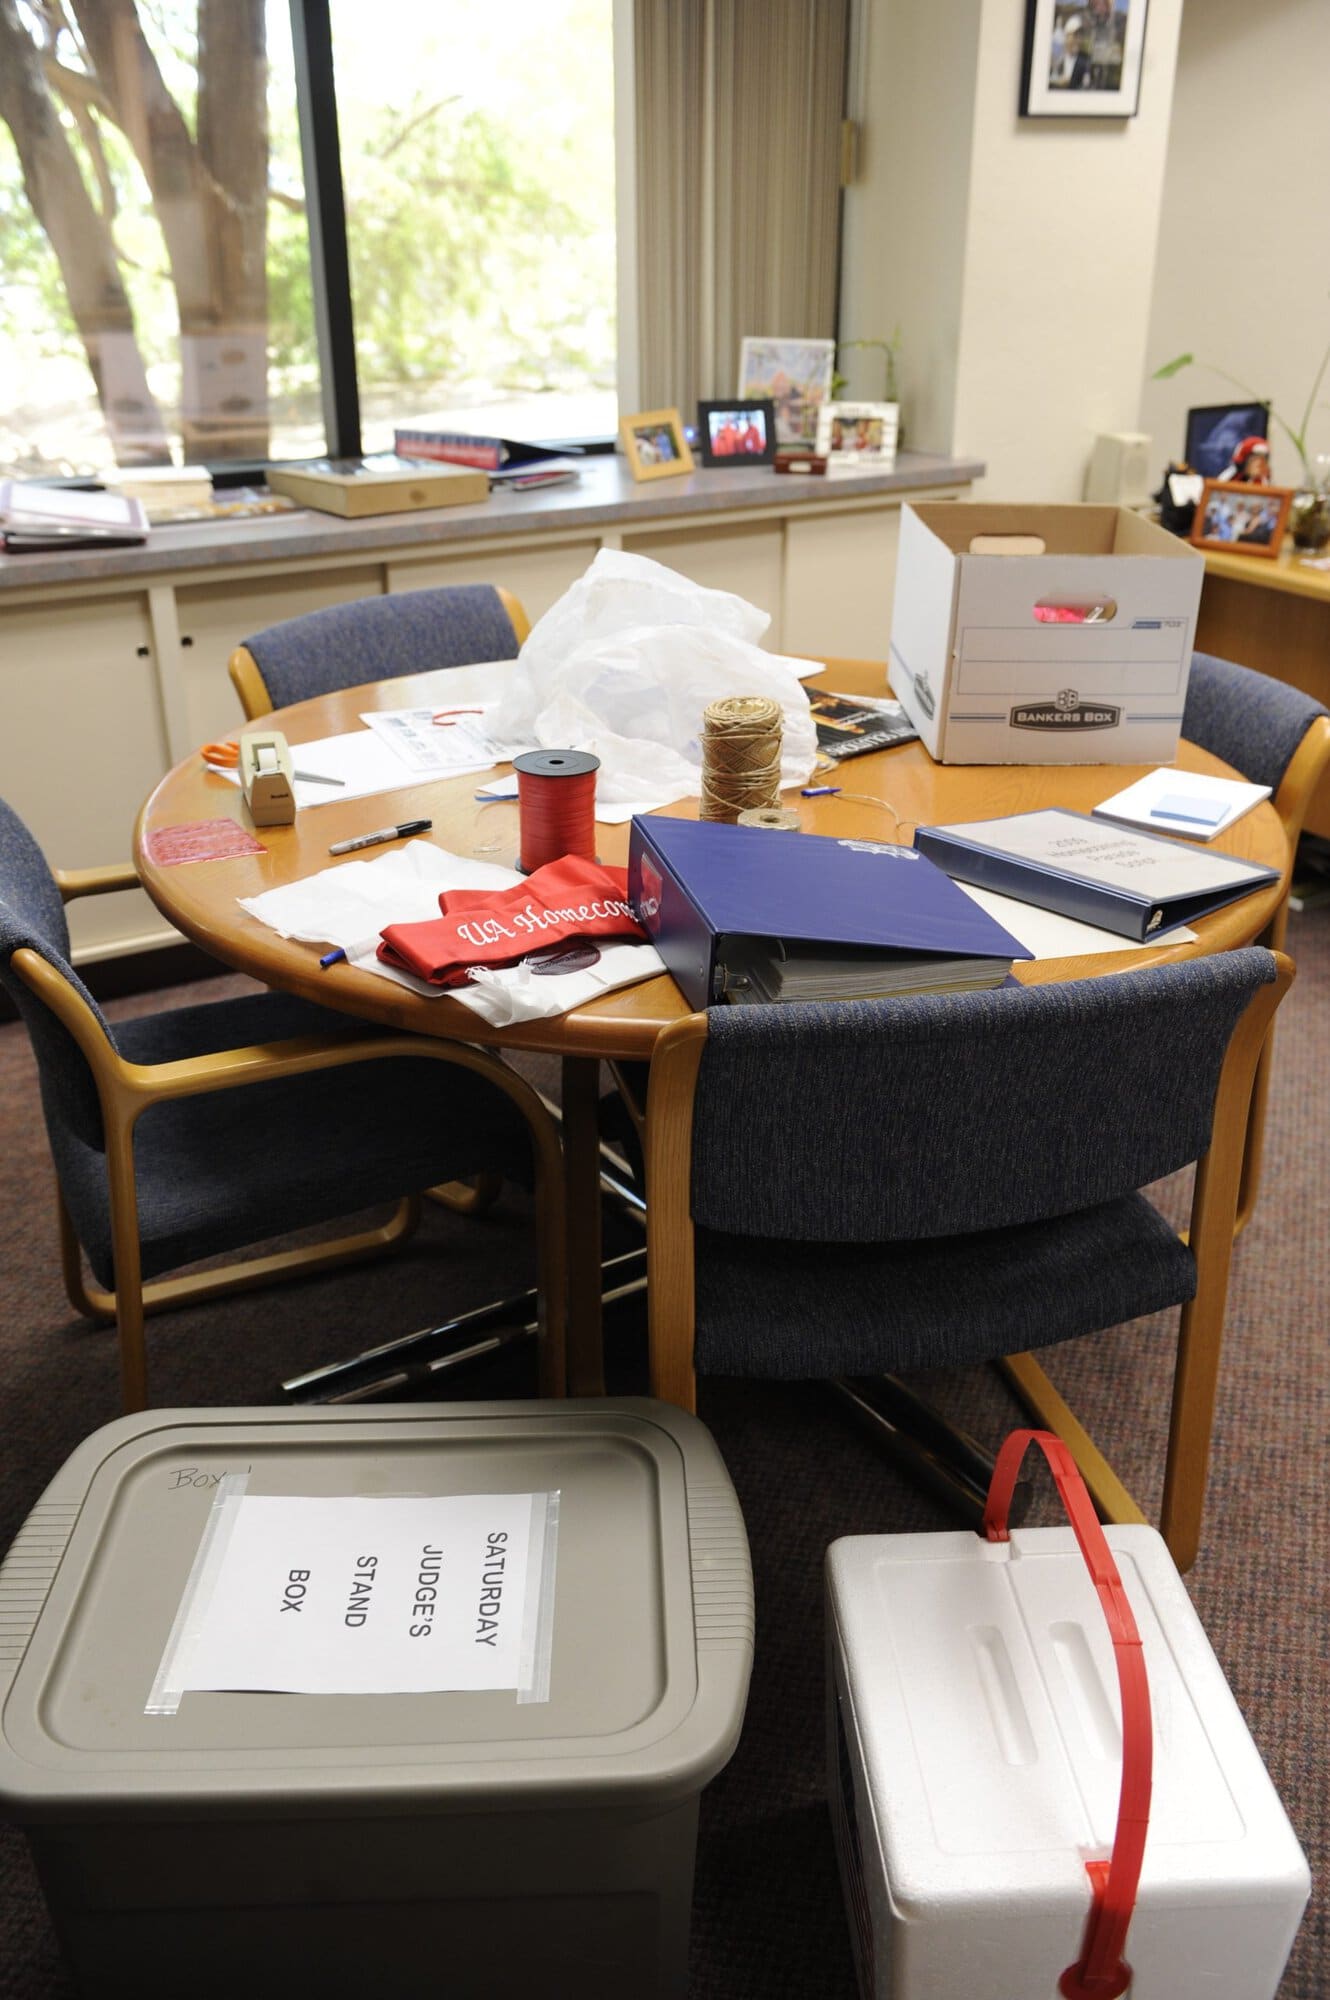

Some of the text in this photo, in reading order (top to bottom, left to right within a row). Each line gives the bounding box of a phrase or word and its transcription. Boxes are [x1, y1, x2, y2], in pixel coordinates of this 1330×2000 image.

[1017, 712, 1113, 722] BANKERS BOX
[457, 918, 517, 946] UA
[280, 1569, 311, 1613] BOX
[345, 1556, 378, 1628] STAND
[409, 1544, 443, 1638] JUDGE'S
[475, 1531, 508, 1647] SATURDAY
